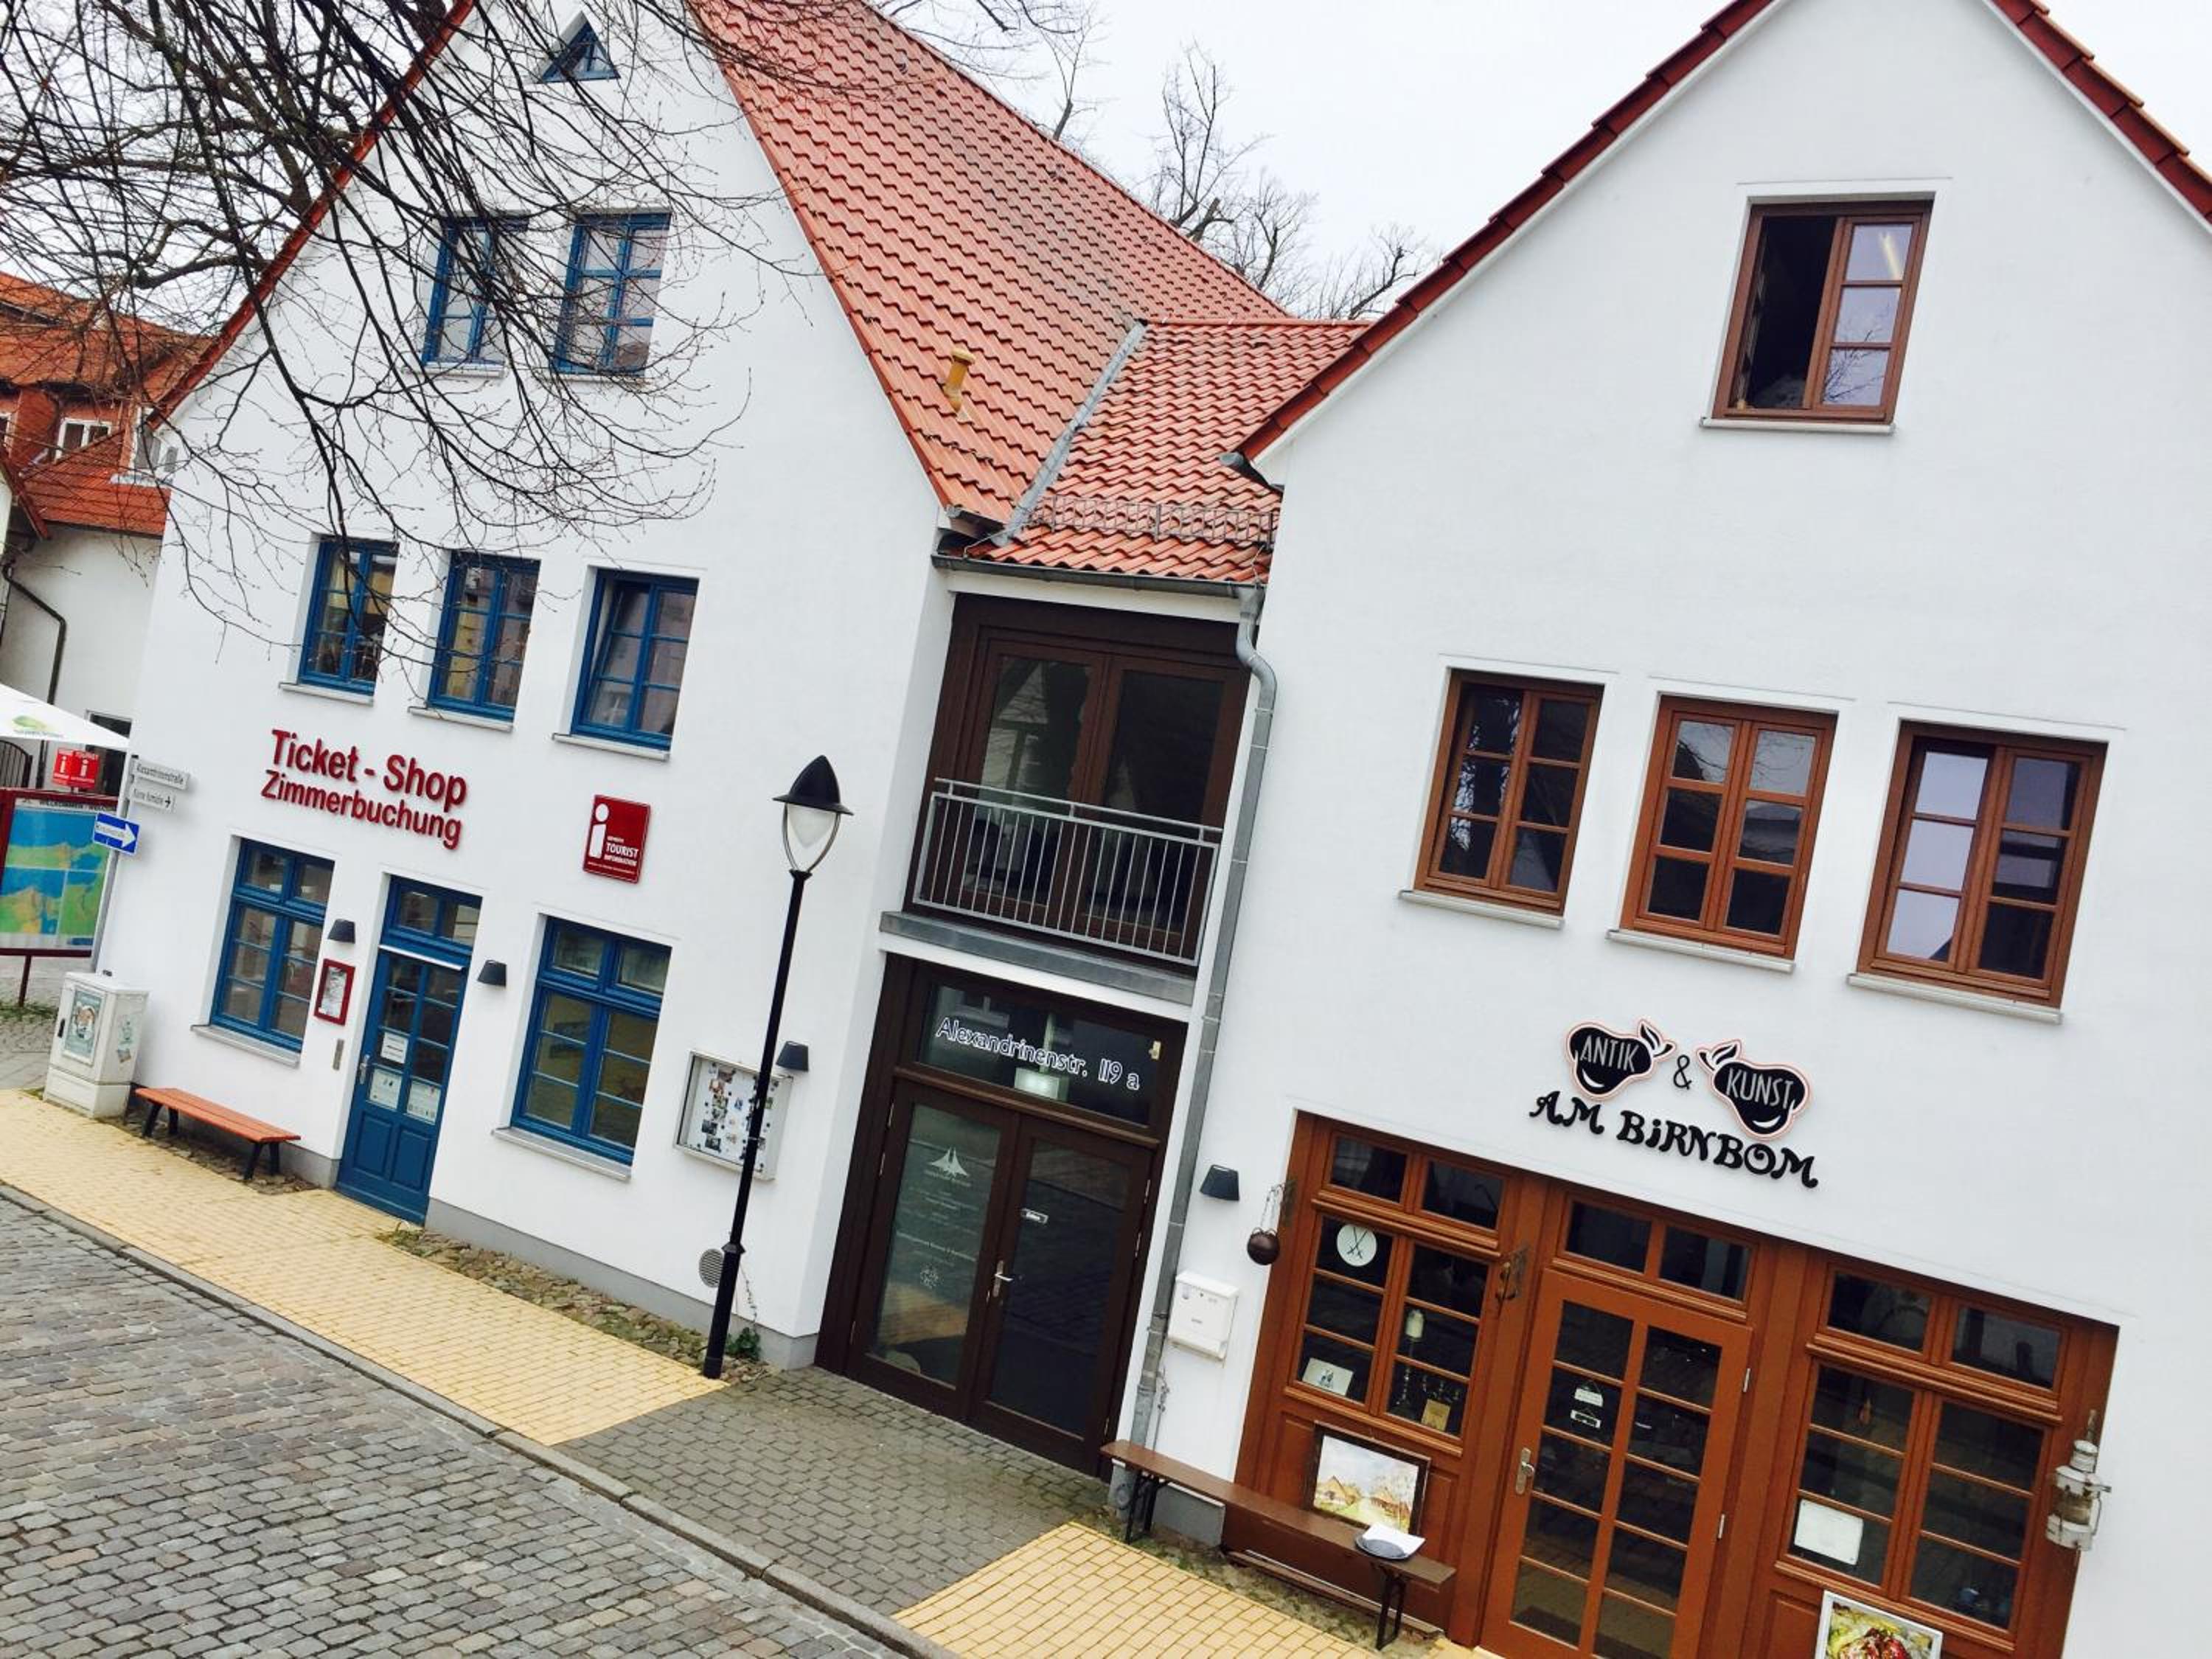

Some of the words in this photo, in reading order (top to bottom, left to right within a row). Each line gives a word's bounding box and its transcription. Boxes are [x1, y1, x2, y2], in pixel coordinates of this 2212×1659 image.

[272, 728, 359, 783] Ticket
[383, 754, 467, 813] Shop
[260, 769, 462, 849] Zimmerbuchung
[605, 843, 639, 858] TOURIST
[935, 1017, 1088, 1077] Alexandrinenstr.
[1098, 1058, 1123, 1085] 119
[1127, 1072, 1141, 1091] a
[1579, 1034, 1641, 1073] ANTIK
[1672, 1054, 1693, 1091] &
[1725, 1067, 1795, 1110] KUNST
[1528, 1090, 1605, 1135] AM
